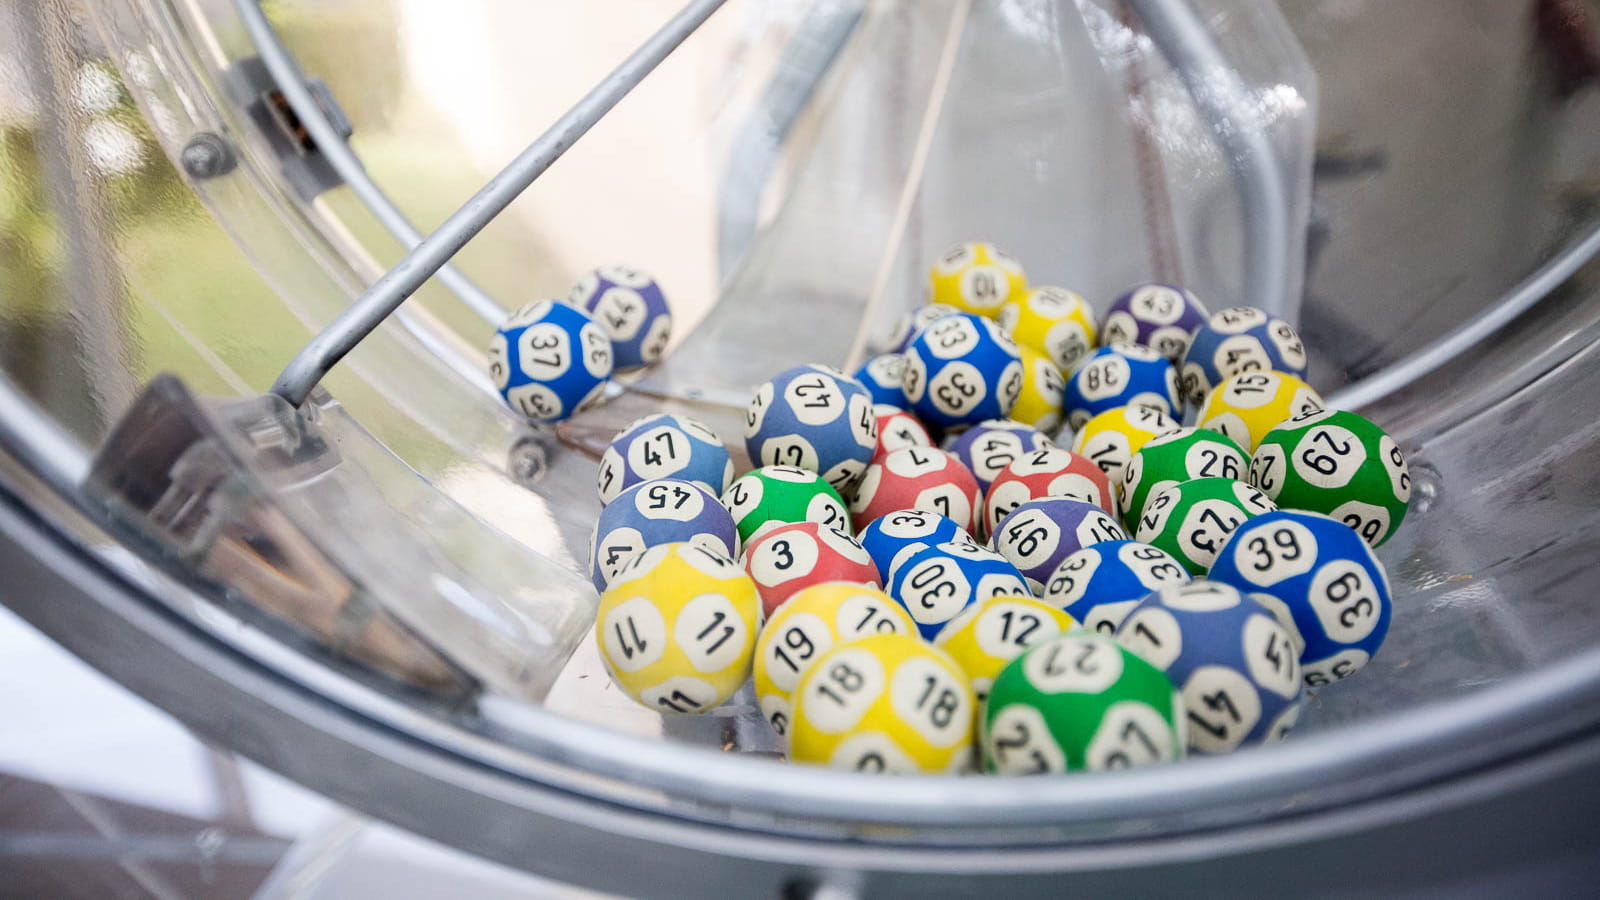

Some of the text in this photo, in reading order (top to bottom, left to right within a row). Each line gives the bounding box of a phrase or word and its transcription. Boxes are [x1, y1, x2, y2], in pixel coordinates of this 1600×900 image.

[606, 297, 635, 329] 44
[1144, 297, 1174, 318] 43
[531, 335, 562, 368] 37
[934, 321, 967, 348] 33
[795, 378, 831, 408] 42
[937, 372, 976, 410] 33
[1087, 361, 1119, 391] 38
[1234, 376, 1270, 395] 15
[644, 432, 676, 466] 47
[909, 449, 930, 466] 7
[983, 440, 1015, 470] 40
[1031, 451, 1049, 466] 2
[1091, 443, 1122, 473] 14
[1197, 449, 1238, 480] 26
[1300, 430, 1349, 476] 29
[1249, 455, 1275, 491] 29
[649, 485, 692, 510] 45
[1008, 518, 1048, 557] 46
[1188, 508, 1238, 554] 23
[771, 540, 794, 570] 3
[1132, 547, 1182, 581] 36
[1248, 528, 1302, 572] 39
[911, 564, 956, 609] 30
[1050, 557, 1087, 596] 36
[1326, 571, 1374, 629] 39
[615, 616, 647, 659] 11
[697, 611, 735, 655] 11
[999, 611, 1041, 646] 12
[774, 627, 815, 673] 19
[1043, 643, 1098, 677] 27
[658, 689, 702, 713] 11
[816, 663, 864, 706] 18
[916, 675, 959, 730] 18
[1188, 690, 1242, 740] 41
